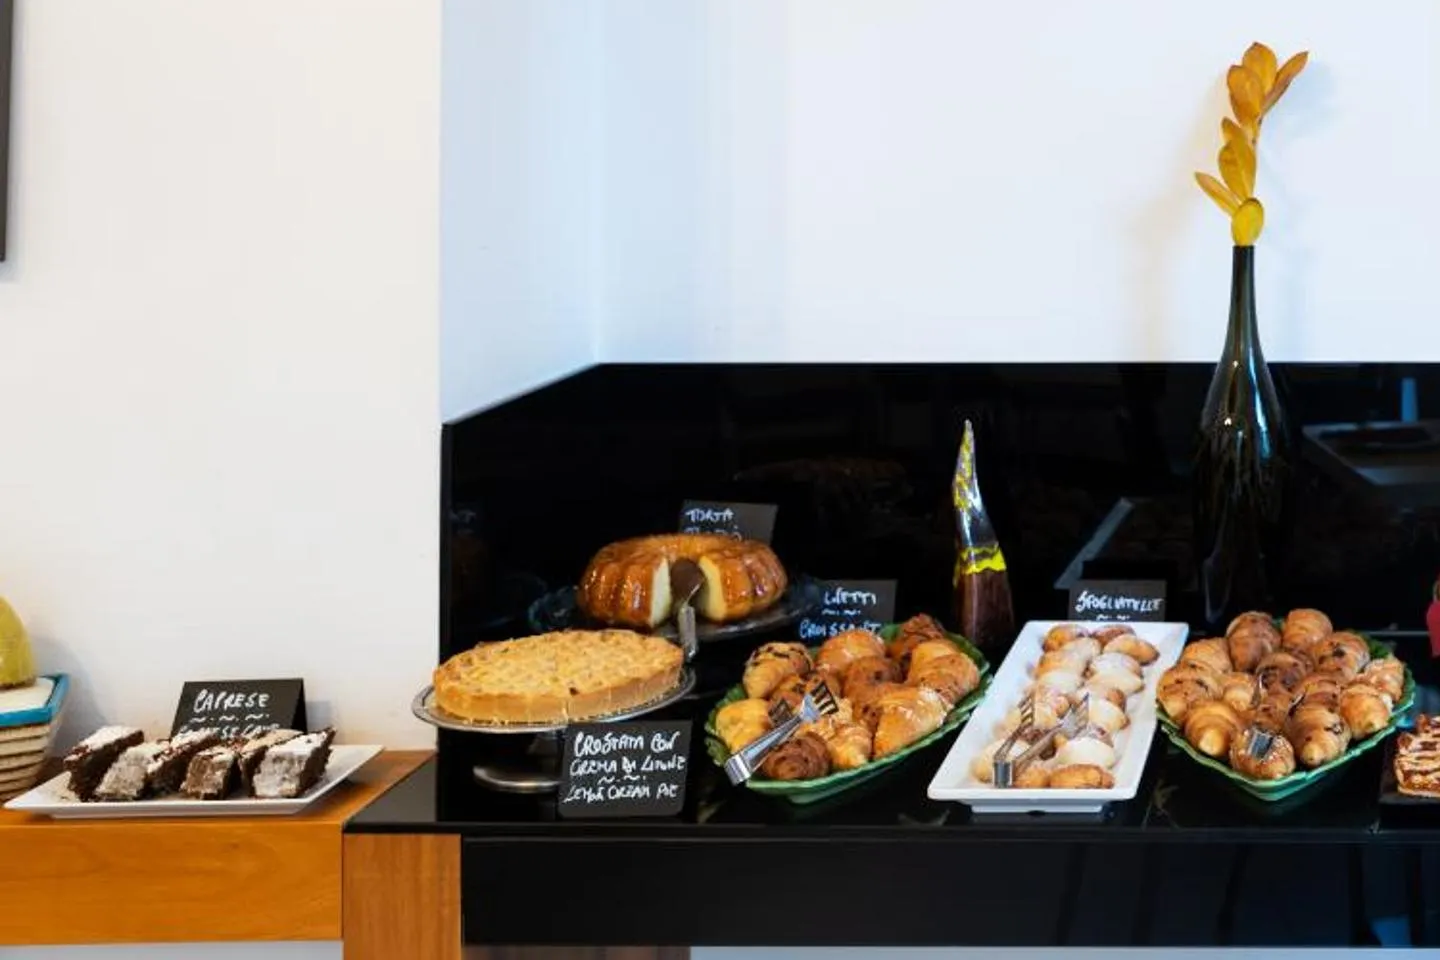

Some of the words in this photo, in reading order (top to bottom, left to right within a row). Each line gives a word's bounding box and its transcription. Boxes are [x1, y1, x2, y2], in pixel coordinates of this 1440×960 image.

[685, 507, 734, 523] TORTA
[193, 689, 270, 713] CAPRESE
[651, 731, 680, 752] CON
[570, 758, 617, 776] CREMA
[608, 784, 649, 799] CREAM
[657, 782, 678, 799] PIE
